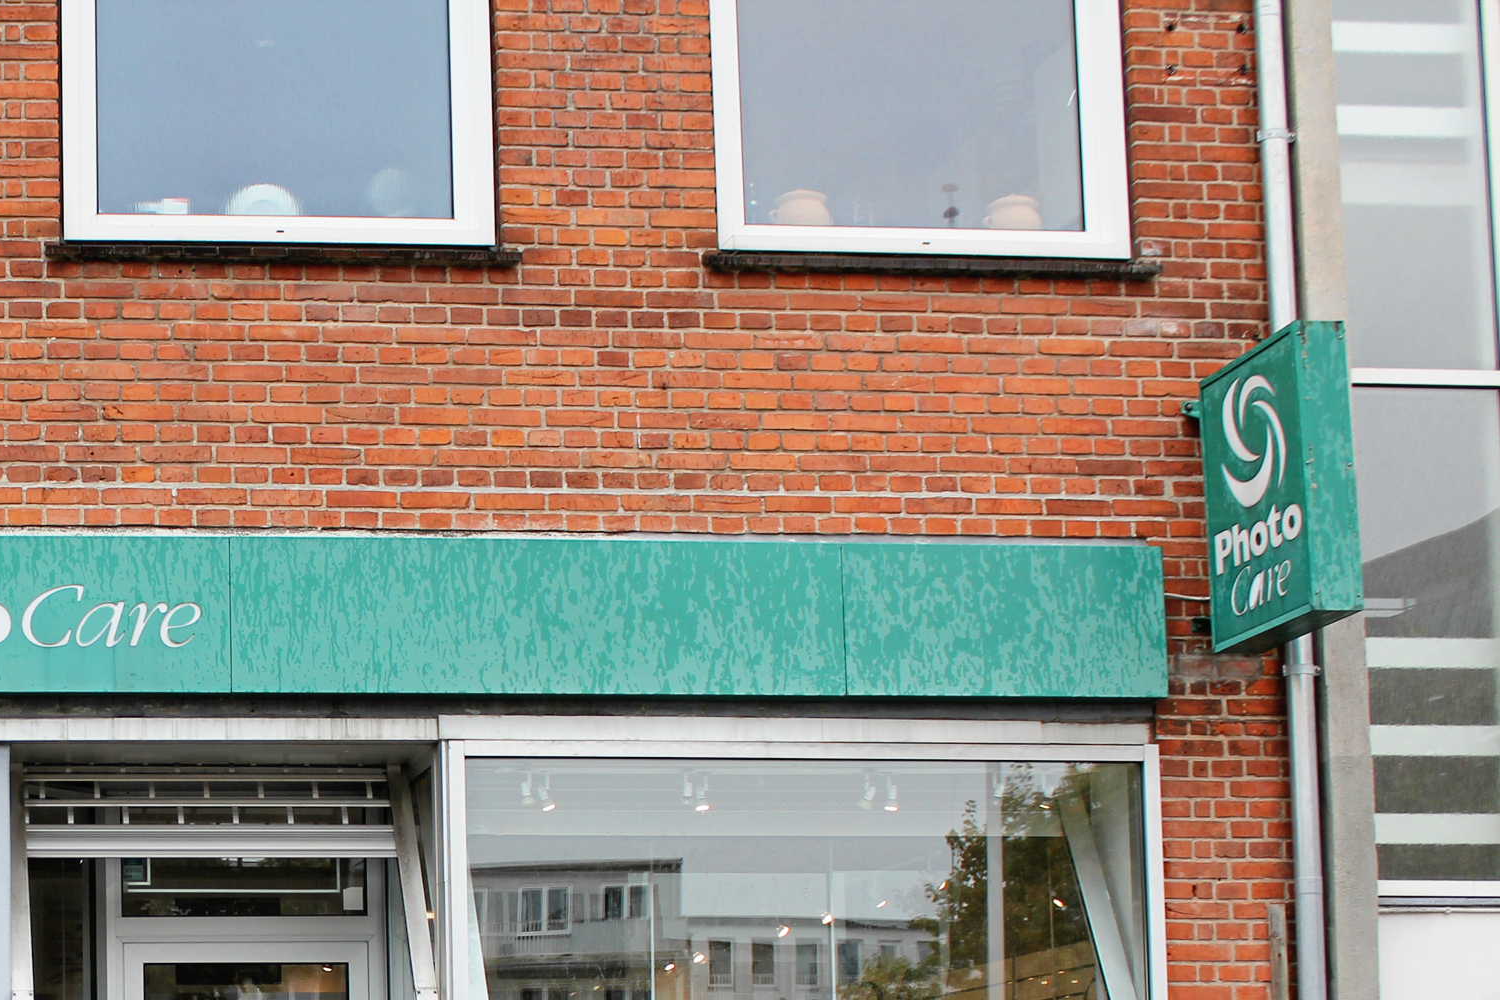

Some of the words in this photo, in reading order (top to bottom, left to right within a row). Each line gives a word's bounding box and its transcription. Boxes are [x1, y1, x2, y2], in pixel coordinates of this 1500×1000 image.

[1213, 503, 1303, 576] Photo
[20, 584, 203, 649] Care
[1230, 559, 1292, 617] Care
